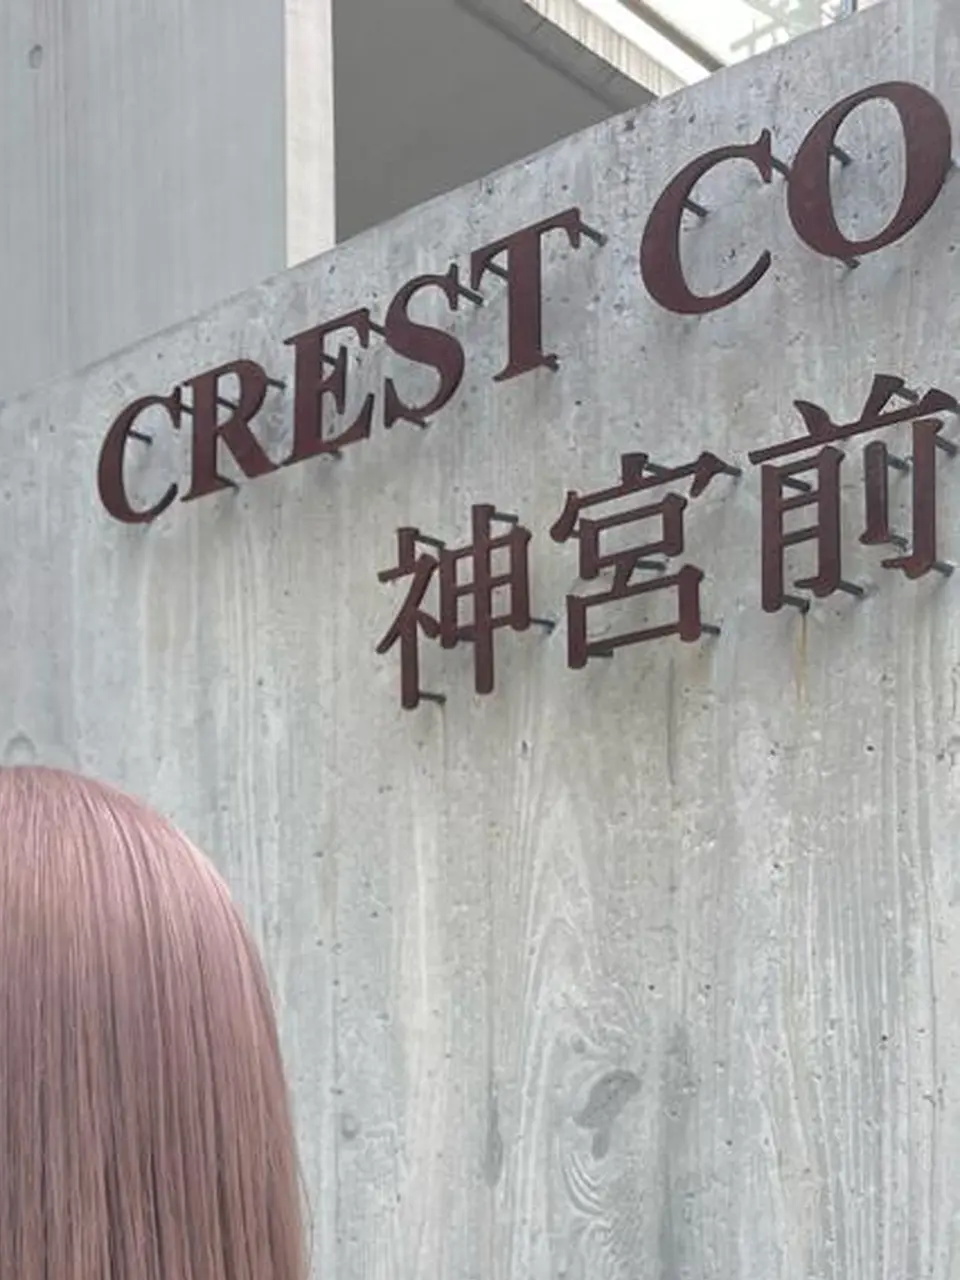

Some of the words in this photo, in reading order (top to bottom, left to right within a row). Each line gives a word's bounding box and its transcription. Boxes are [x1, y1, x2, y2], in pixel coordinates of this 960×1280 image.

[97, 207, 581, 524] CREST
[640, 80, 954, 315] CO
[376, 373, 959, 710] 神宮前
